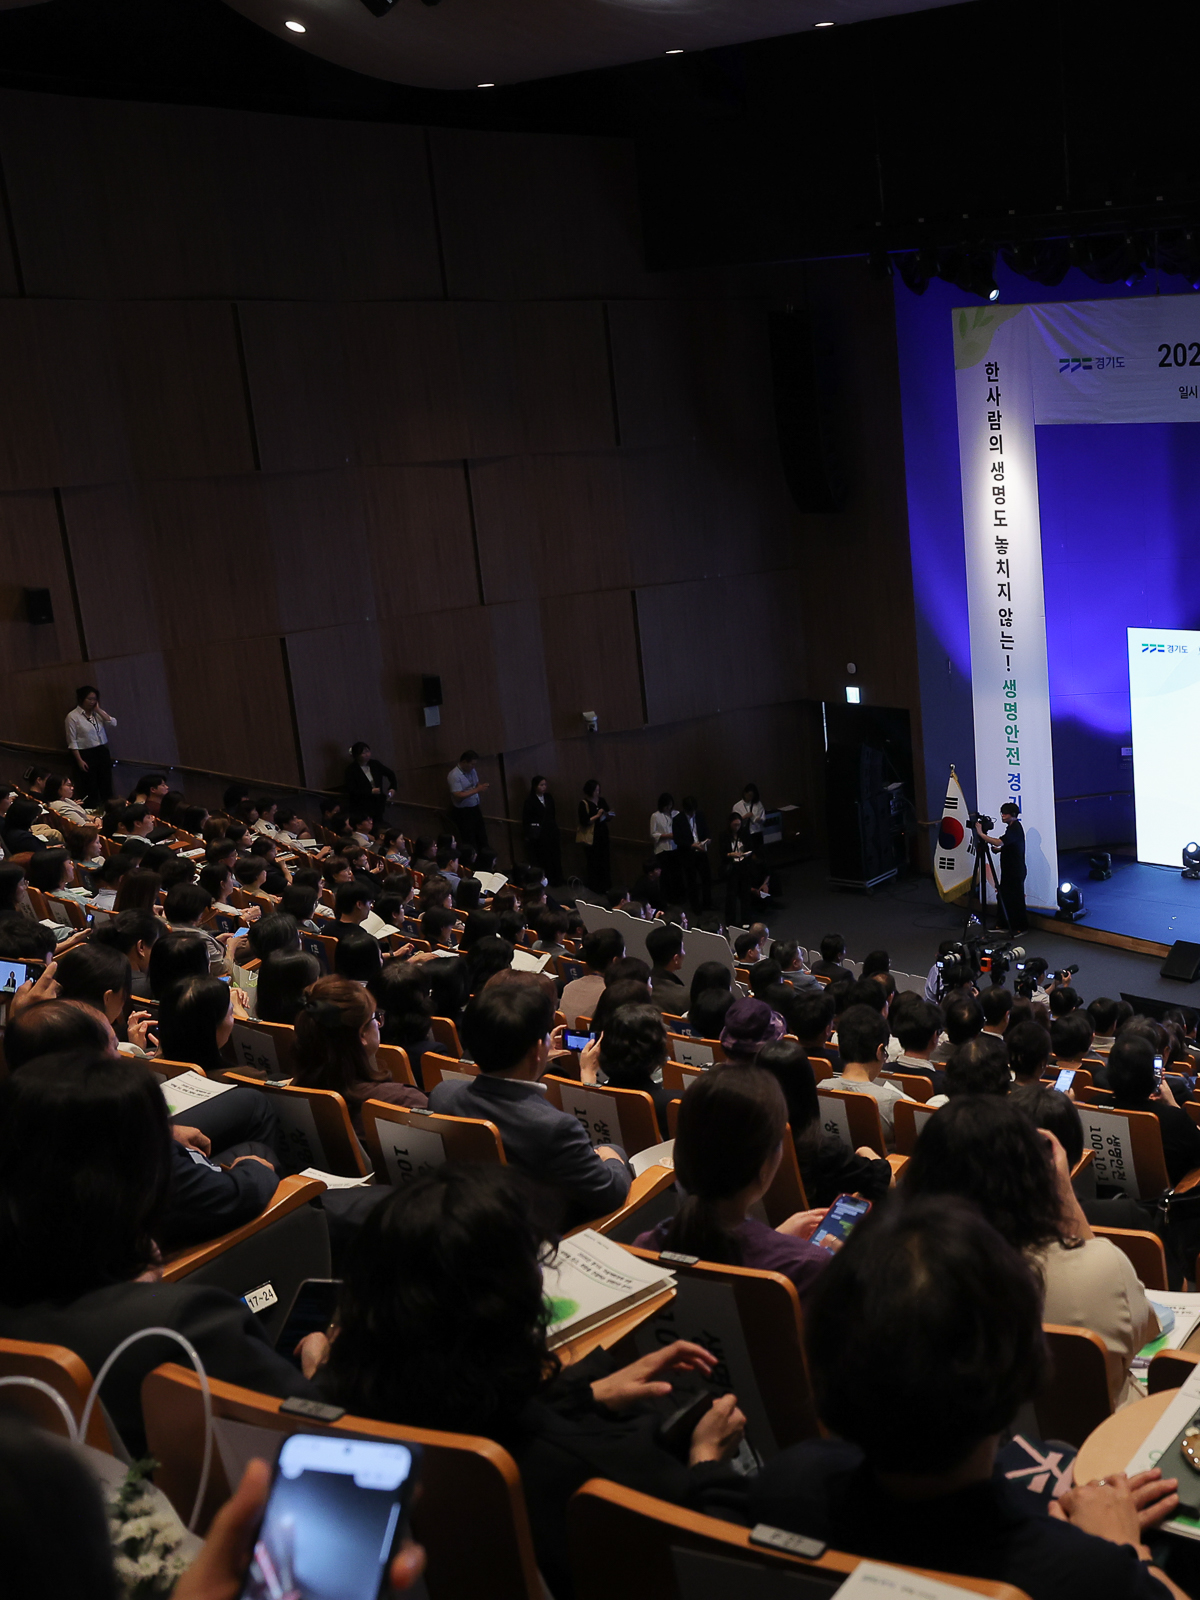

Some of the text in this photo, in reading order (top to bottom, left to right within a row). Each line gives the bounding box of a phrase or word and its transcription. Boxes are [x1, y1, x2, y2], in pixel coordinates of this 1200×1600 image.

[1095, 355, 1125, 369] 경기도
[1179, 386, 1197, 399] 일시
[991, 462, 1007, 526] 생명도
[995, 536, 1011, 601] 놓치지
[1167, 645, 1188, 653] 경기도
[1003, 680, 1020, 765] 생명안전
[1008, 773, 1022, 822] 경기
[1107, 1135, 1126, 1181] 생명안전
